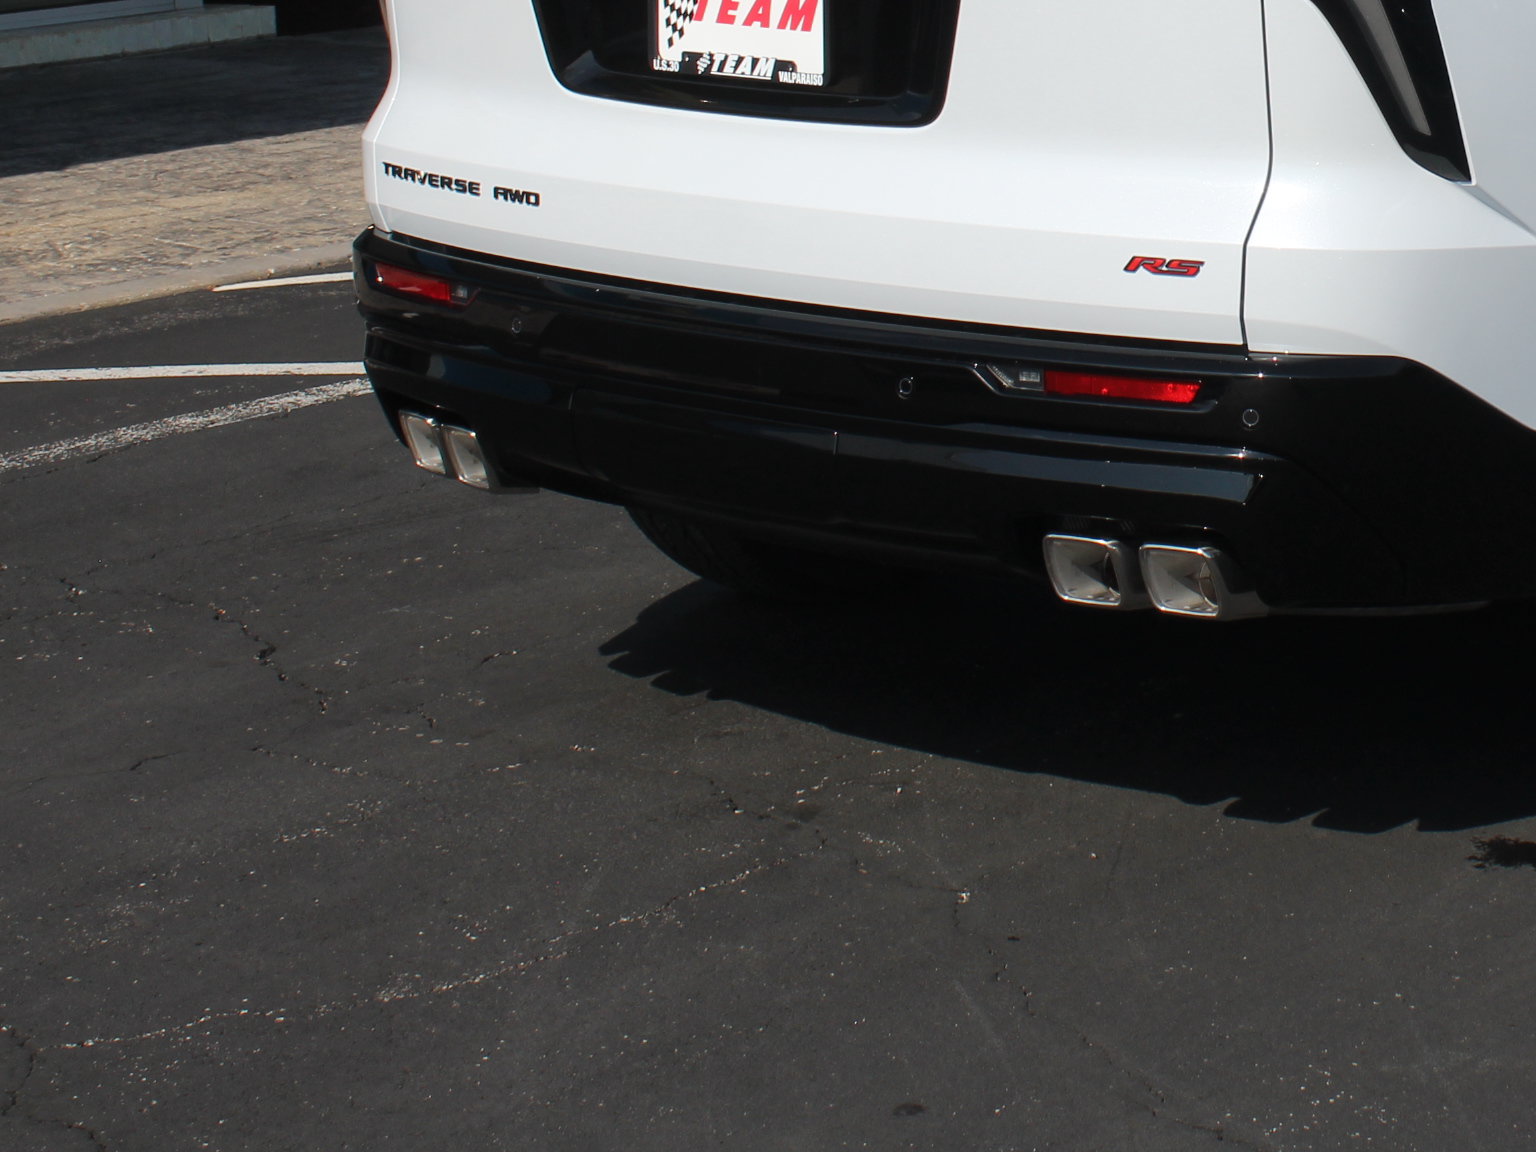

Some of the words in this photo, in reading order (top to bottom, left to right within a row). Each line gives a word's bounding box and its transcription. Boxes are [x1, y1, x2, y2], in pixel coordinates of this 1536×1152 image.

[711, 53, 777, 77] TEAM
[778, 71, 823, 86] VALPARAISO
[382, 161, 481, 196] TRAVERSE
[493, 186, 541, 207] AWD
[1123, 255, 1205, 278] RS
